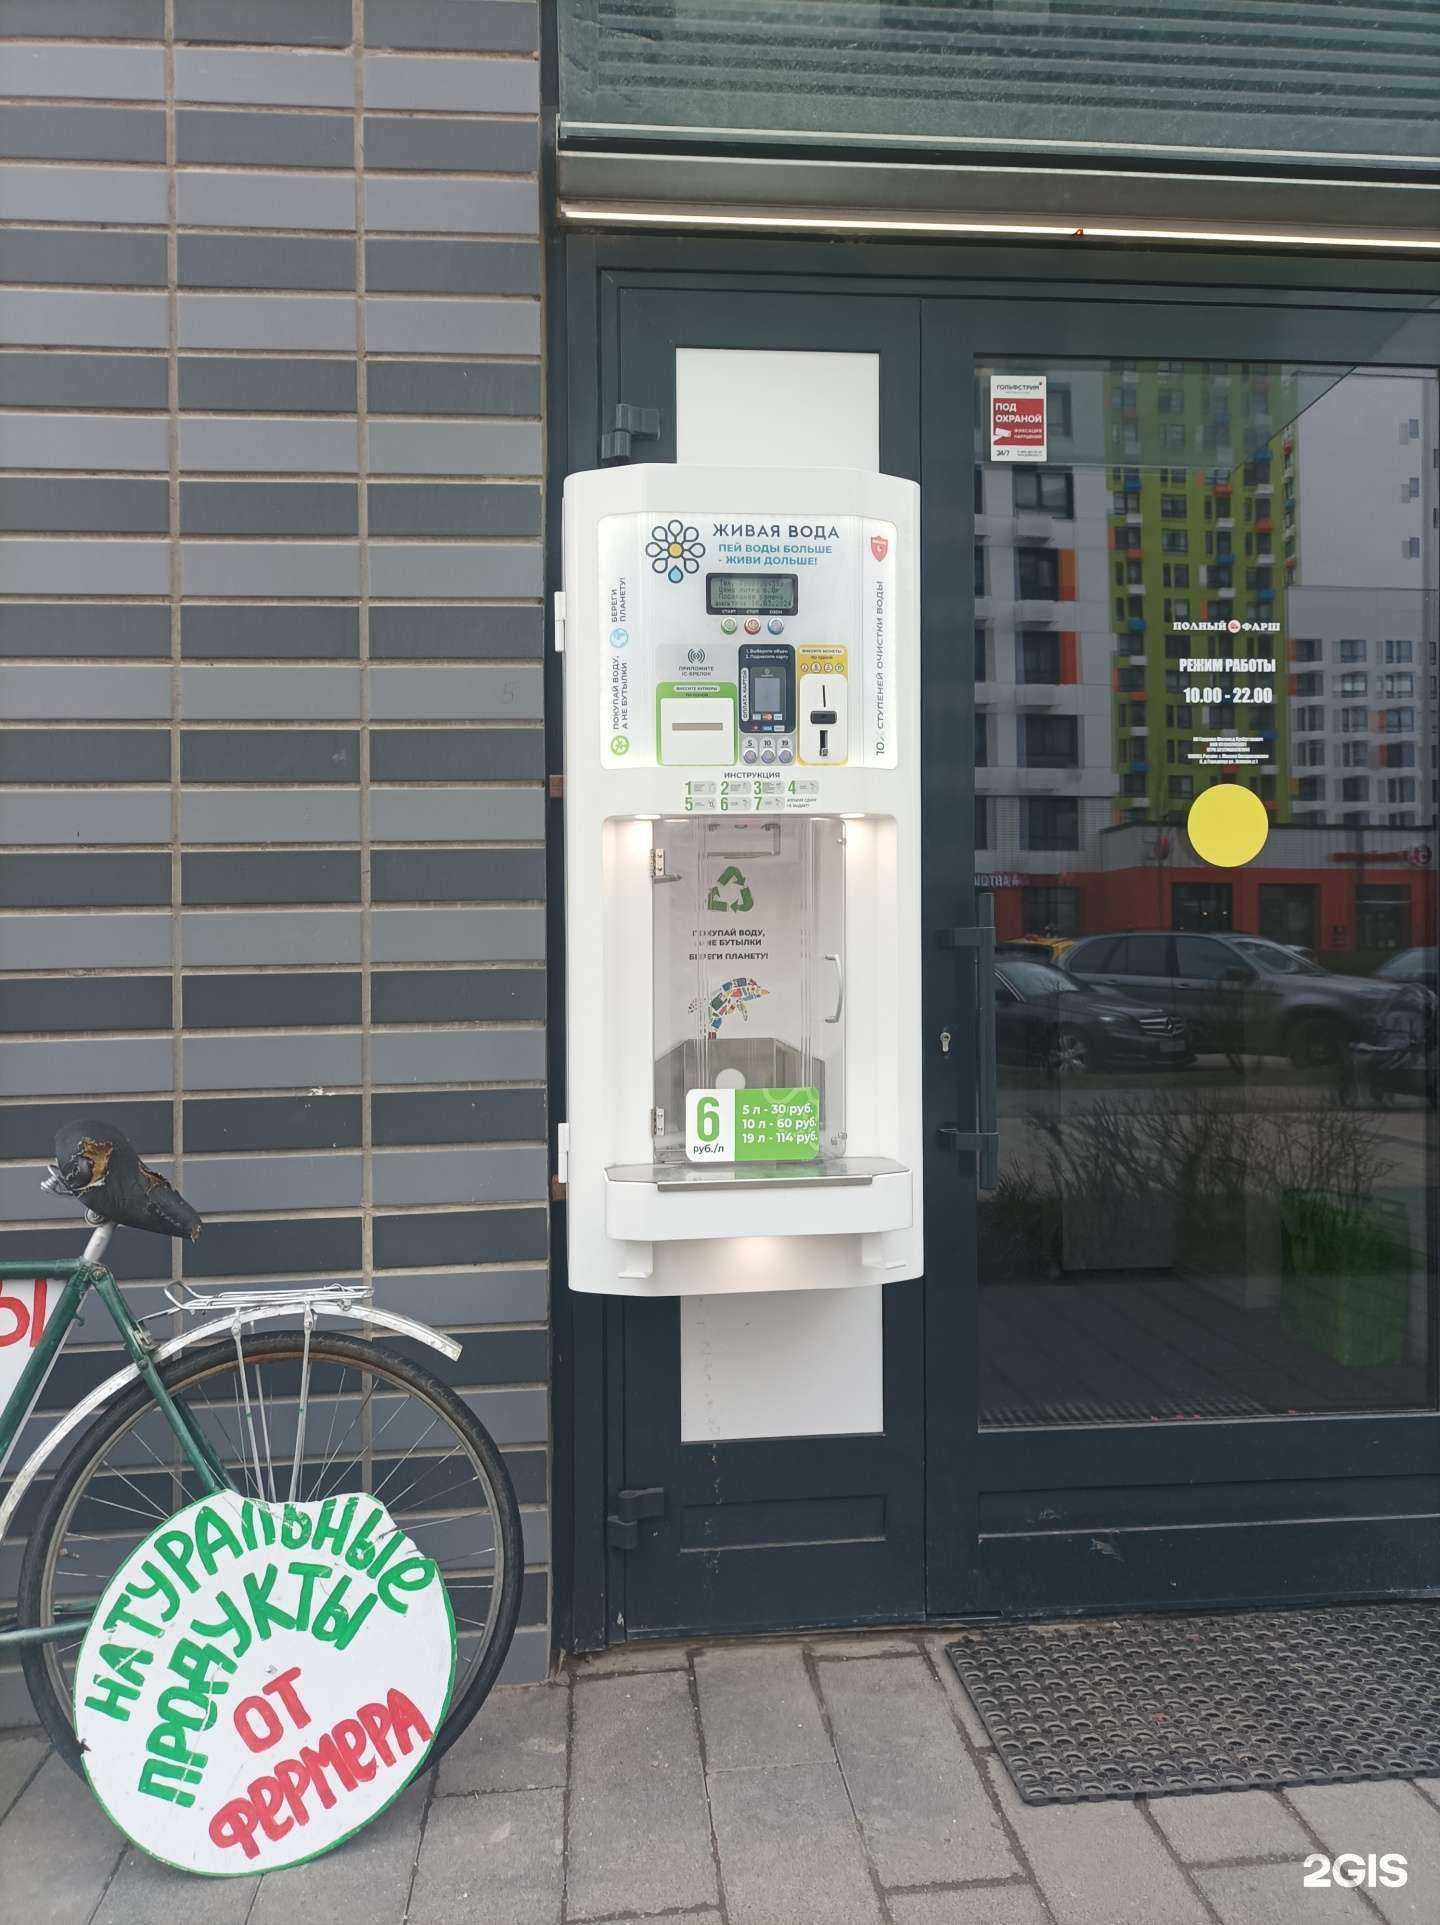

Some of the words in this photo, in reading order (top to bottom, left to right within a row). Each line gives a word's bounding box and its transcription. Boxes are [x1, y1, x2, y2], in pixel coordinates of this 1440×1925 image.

[995, 402, 1017, 412] ПОД
[995, 414, 1042, 423] ОХРАНОЙ
[712, 524, 780, 537] ЖИВАЯ
[788, 525, 840, 540] ВОДА
[719, 543, 742, 553] ПЕЙ
[745, 544, 780, 554] ВОДЫ
[783, 545, 833, 554] БОЛЬШЕ
[726, 556, 761, 565] ЖИВИ
[763, 556, 817, 566] ДОЛЬШЕ!
[876, 580, 884, 615] ВОДЫ
[1173, 620, 1227, 631] ПОЛНЫЙ
[1241, 622, 1280, 631] ФАРШ
[876, 618, 884, 669] ОЧИСТКИ
[612, 655, 620, 683] ВОДУ,
[1179, 659, 1223, 672] РЕЖИМ
[1225, 658, 1276, 673] РАБОТЫ
[876, 672, 884, 730] СТУПЕНЕЙ
[1183, 687, 1222, 704] 10.00
[1232, 687, 1273, 704] 22.00
[621, 709, 628, 721] НЕ
[684, 781, 692, 795] 1
[720, 781, 729, 795] 2
[754, 781, 762, 795] 3
[788, 780, 796, 794] 4
[685, 797, 693, 811] 5
[720, 797, 729, 811] 6
[754, 797, 762, 811] 7
[739, 929, 766, 937] ВОДУ,
[742, 1105, 750, 1115] 5
[752, 1106, 761, 1114] л
[771, 1104, 786, 1114] 30
[789, 1103, 813, 1116] руб.
[697, 1096, 720, 1142] 6
[742, 1119, 755, 1129] 10
[758, 1121, 766, 1129] л
[777, 1118, 792, 1128] 60
[795, 1118, 817, 1130] руб.
[742, 1134, 755, 1144] 19
[757, 1135, 766, 1143] л
[776, 1133, 794, 1143] 114
[796, 1132, 818, 1144] руб.
[693, 1143, 724, 1154] руб./л
[137, 1562, 378, 1808] ПРОДУКТЫ
[233, 1667, 312, 1753] ОТ
